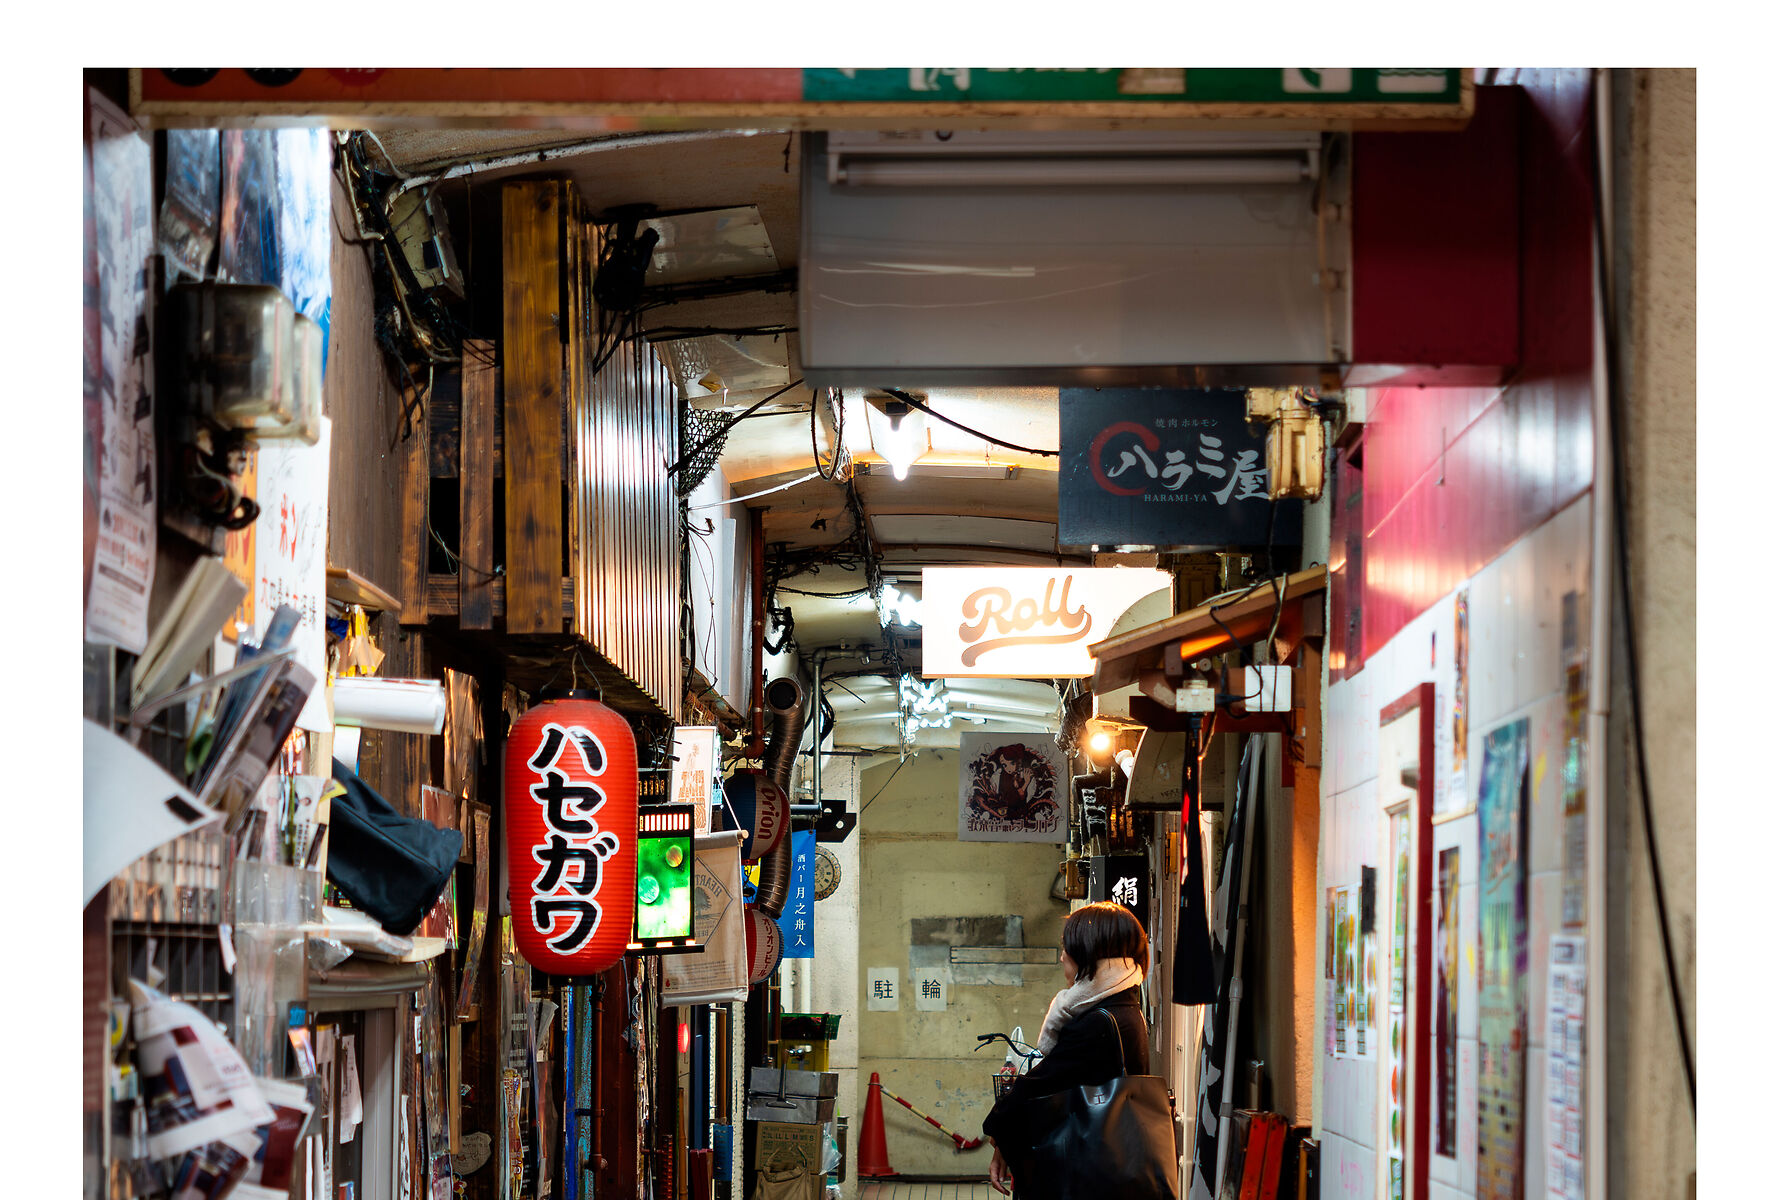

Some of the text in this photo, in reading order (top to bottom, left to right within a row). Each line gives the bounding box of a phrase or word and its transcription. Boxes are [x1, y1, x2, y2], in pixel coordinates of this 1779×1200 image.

[1154, 417, 1219, 429] 焼肉 ホルモン
[1107, 433, 1271, 505] ハラミ屋
[1144, 493, 1208, 502] HARAMI-YA
[958, 574, 1090, 646] Roll
[527, 723, 620, 955] ハセガワ
[758, 788, 779, 839] Orion
[1111, 876, 1138, 907] 絹
[758, 918, 774, 977] オリオンビール
